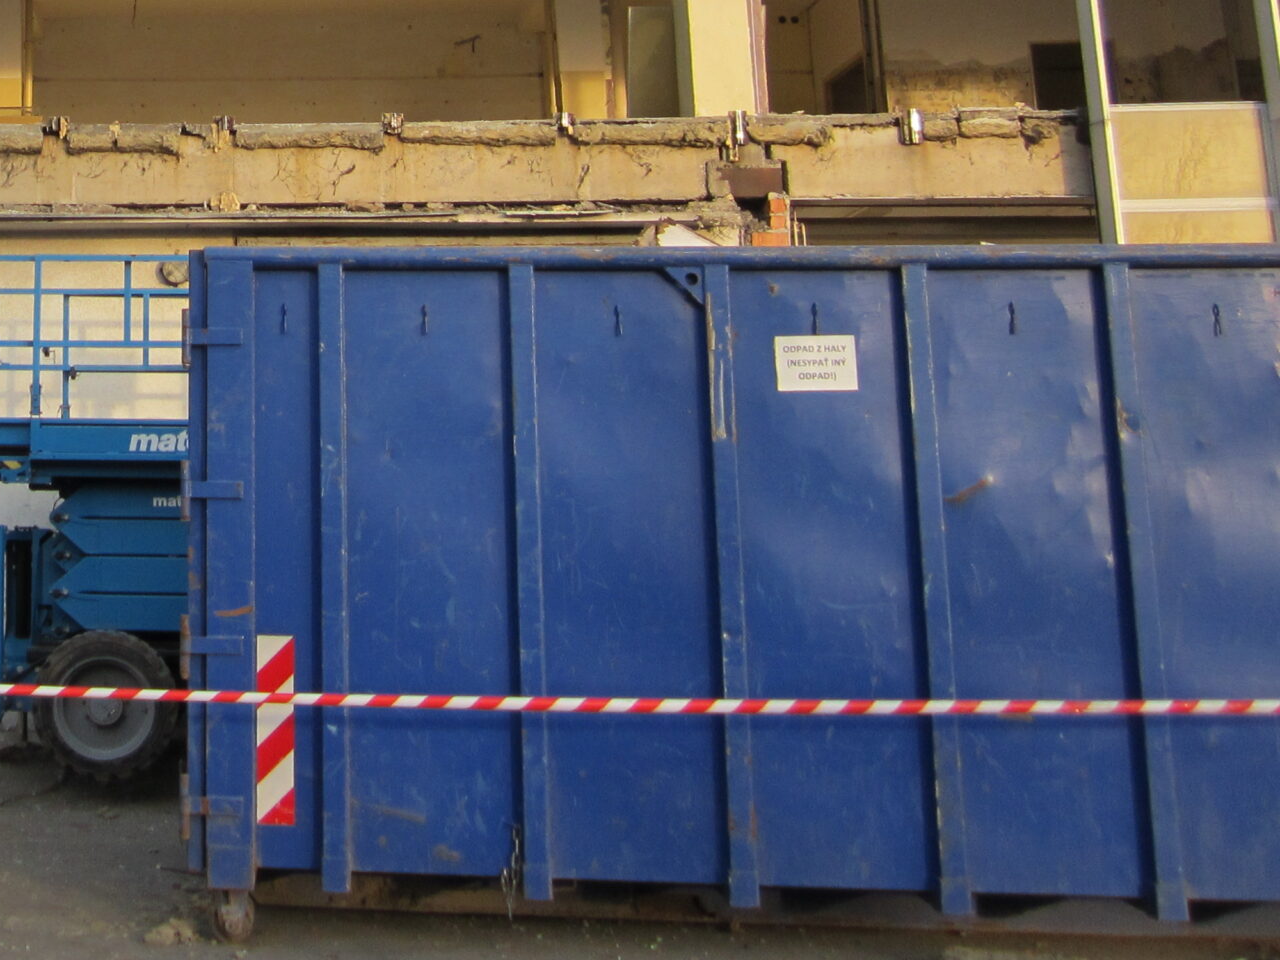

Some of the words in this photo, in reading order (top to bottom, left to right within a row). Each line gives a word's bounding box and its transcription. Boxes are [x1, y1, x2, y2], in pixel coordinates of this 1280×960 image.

[783, 345, 815, 353] ODPAD
[816, 344, 822, 353] Z
[824, 344, 847, 353] HALY
[798, 372, 837, 381] ODPAD!)
[129, 430, 189, 452] mat
